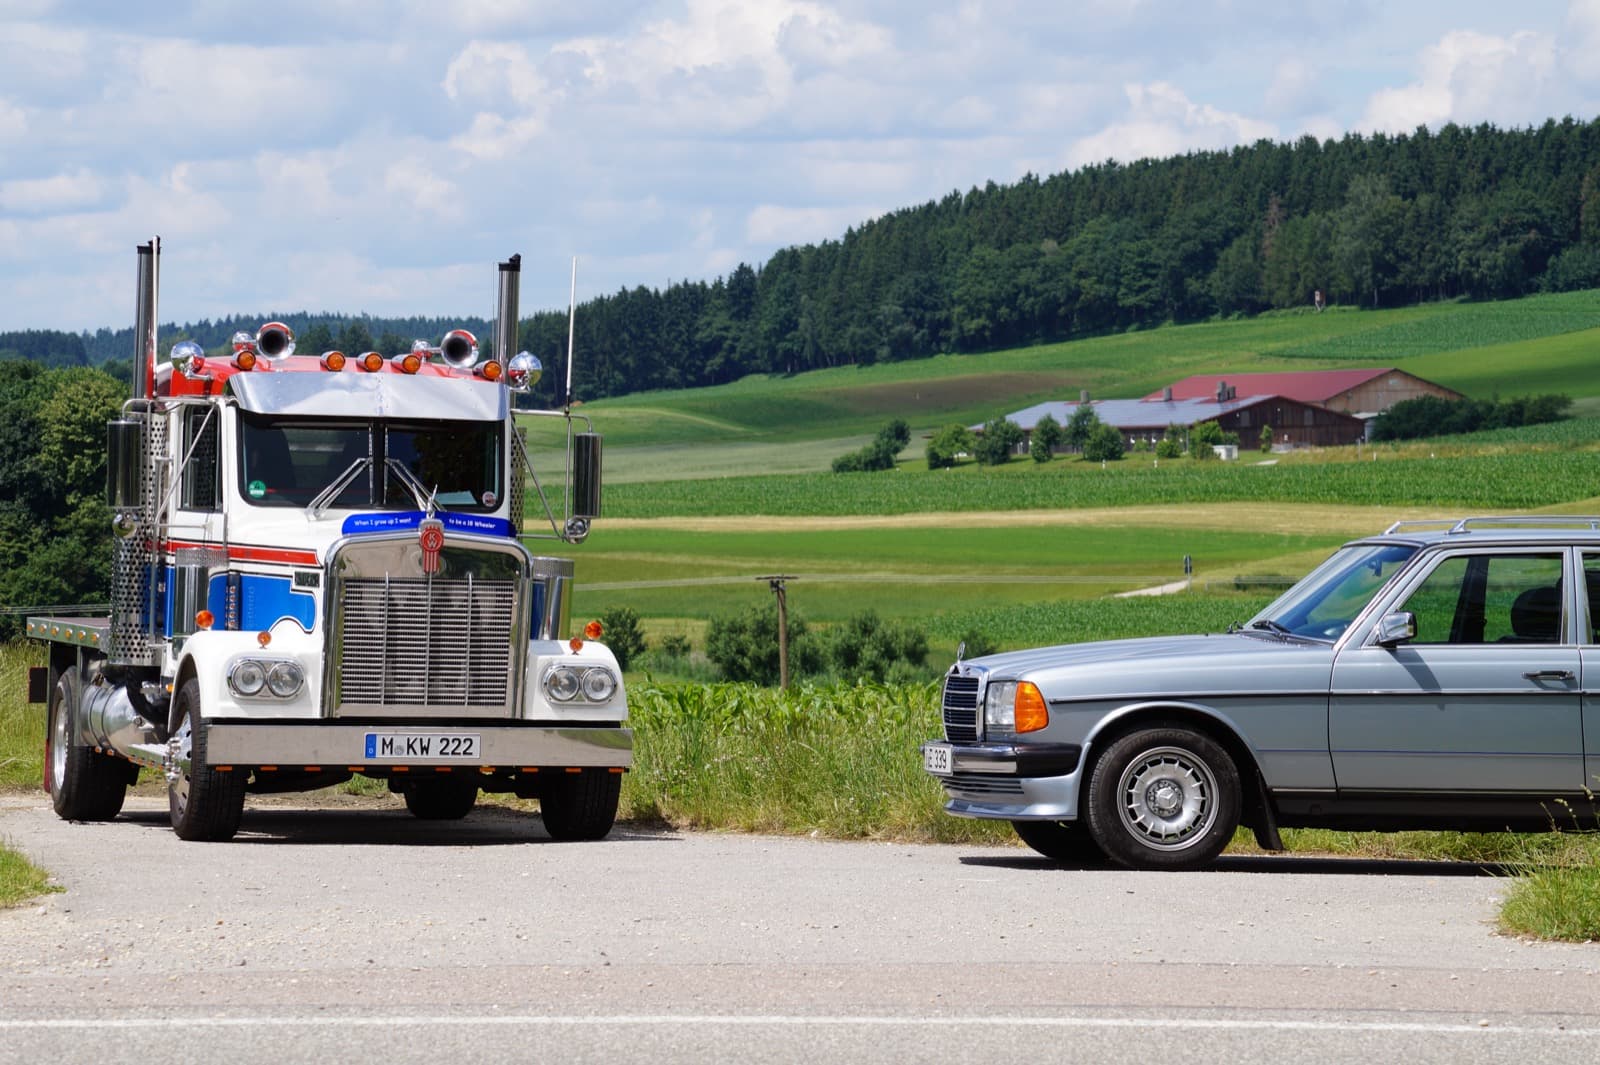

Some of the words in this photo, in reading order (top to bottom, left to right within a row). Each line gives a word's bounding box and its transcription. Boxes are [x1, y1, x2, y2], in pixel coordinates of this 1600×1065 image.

[387, 519, 395, 527] up
[474, 520, 496, 529] Wheeler
[381, 737, 394, 756] M
[406, 737, 431, 756] KW
[439, 737, 473, 756] 222
[935, 749, 947, 769] 339
